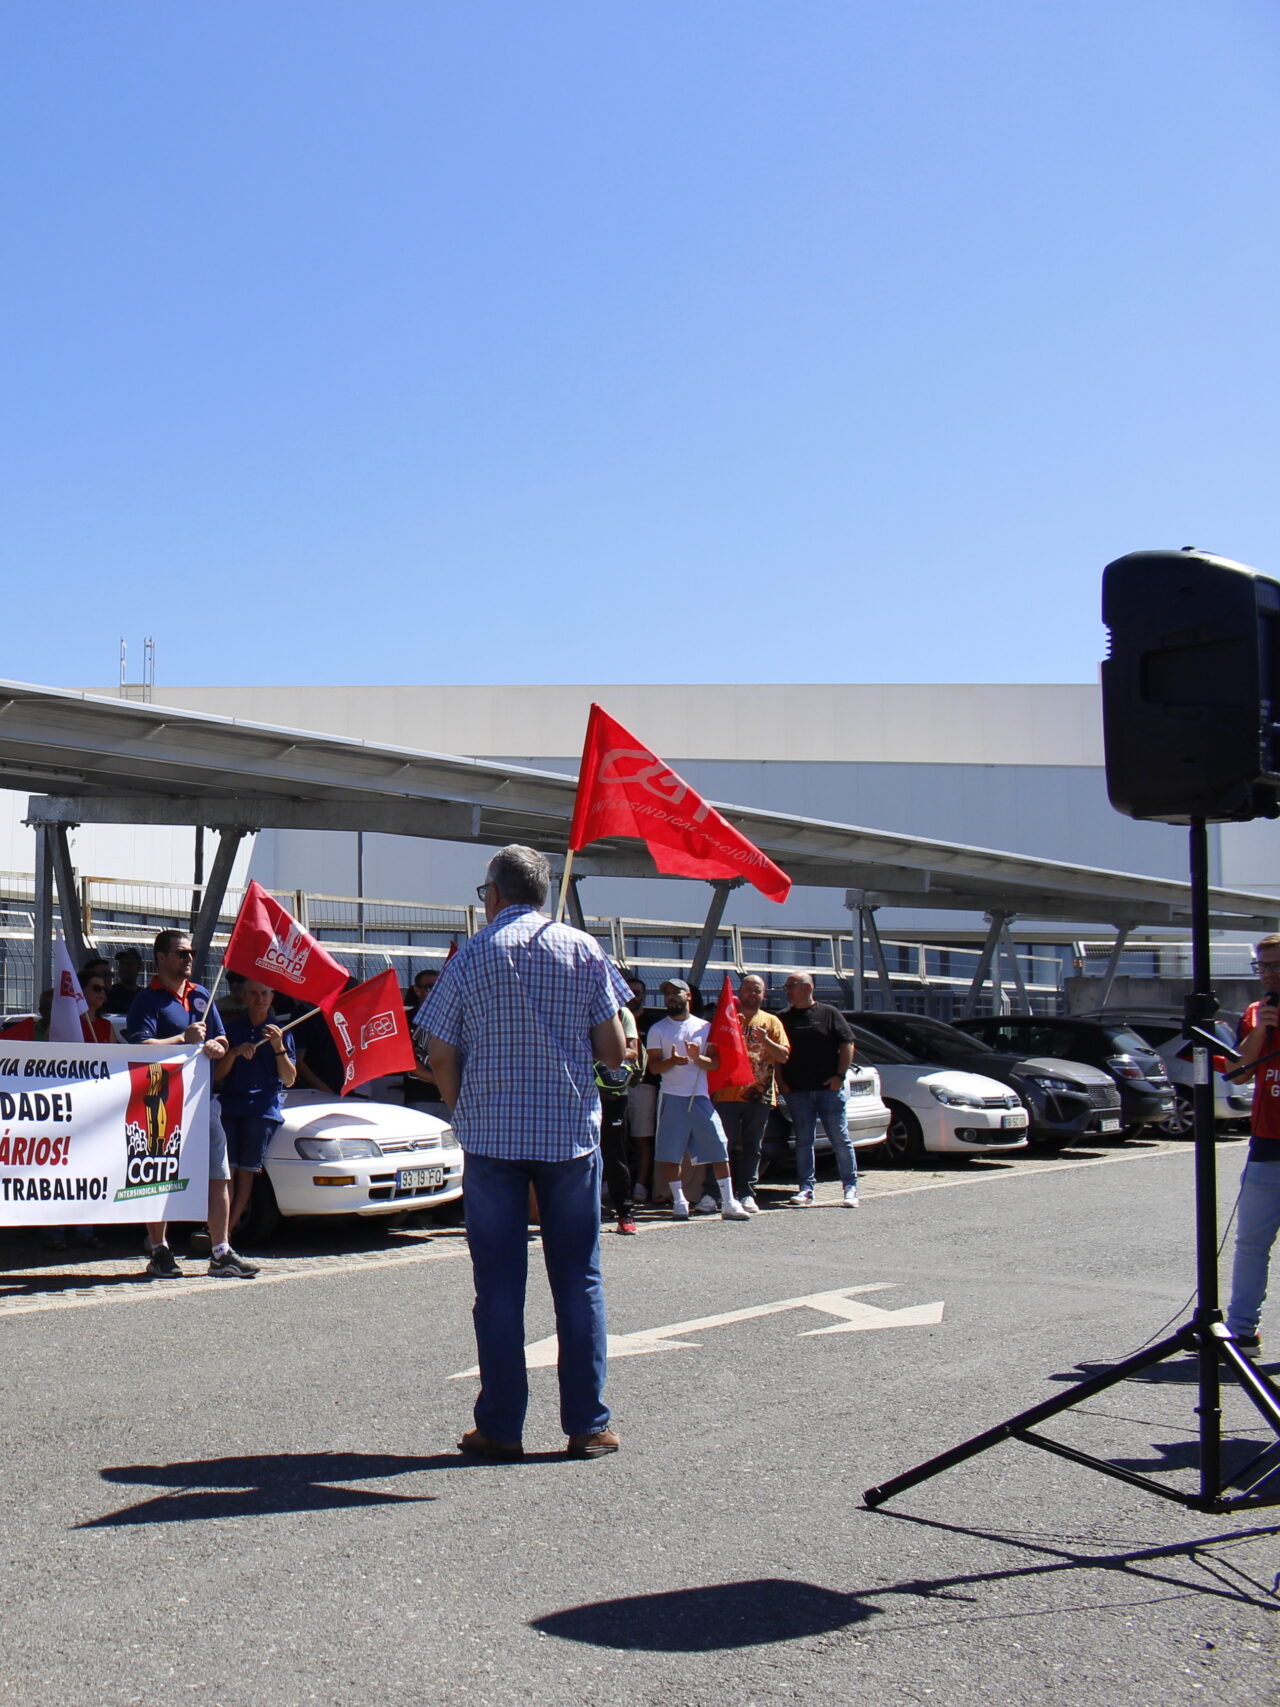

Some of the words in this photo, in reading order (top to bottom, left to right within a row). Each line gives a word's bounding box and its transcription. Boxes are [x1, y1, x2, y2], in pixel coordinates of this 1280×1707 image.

[266, 948, 302, 973] CGTP
[23, 1058, 110, 1083] BRAGANÇA
[127, 1156, 179, 1184] CGTP
[1, 1176, 108, 1201] TRABALHO!
[117, 1184, 158, 1199] INTERSINDICAL
[158, 1182, 184, 1194] NACIONAL
